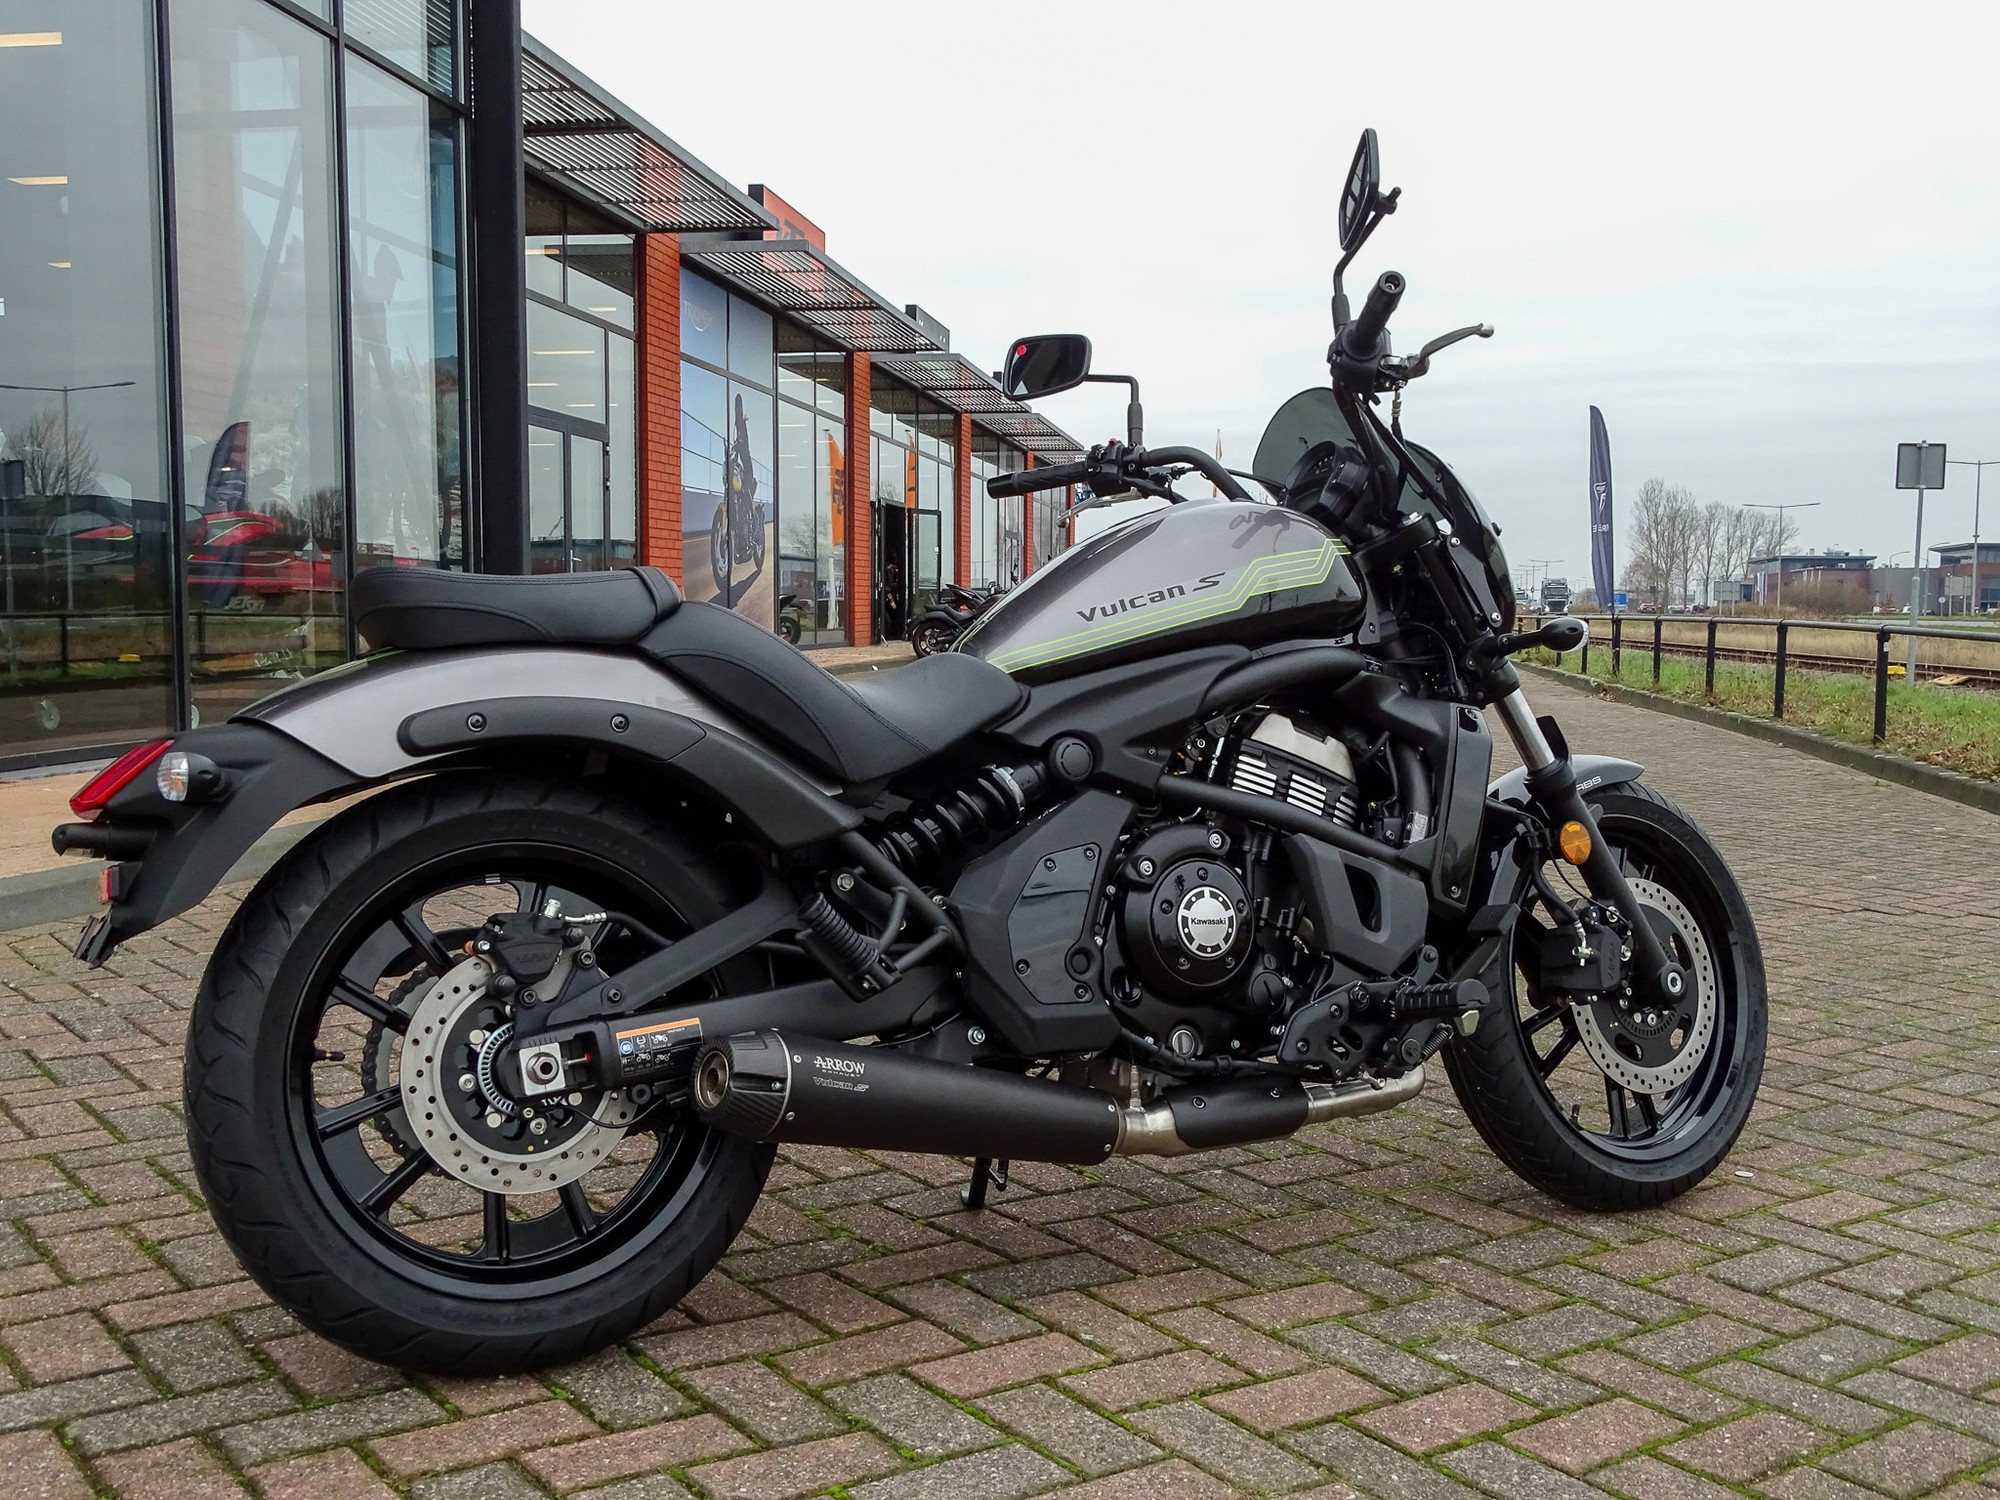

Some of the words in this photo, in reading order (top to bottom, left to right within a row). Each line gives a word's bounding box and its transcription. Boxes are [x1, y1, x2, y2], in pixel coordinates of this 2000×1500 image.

[1192, 571, 1226, 592] S
[1575, 775, 1602, 791] ABS
[1190, 917, 1227, 926] Kawasaki
[813, 1055, 865, 1075] ARROW
[821, 1069, 861, 1078] EXHAUST
[813, 1076, 854, 1091] Vulcan
[854, 1083, 869, 1092] S
